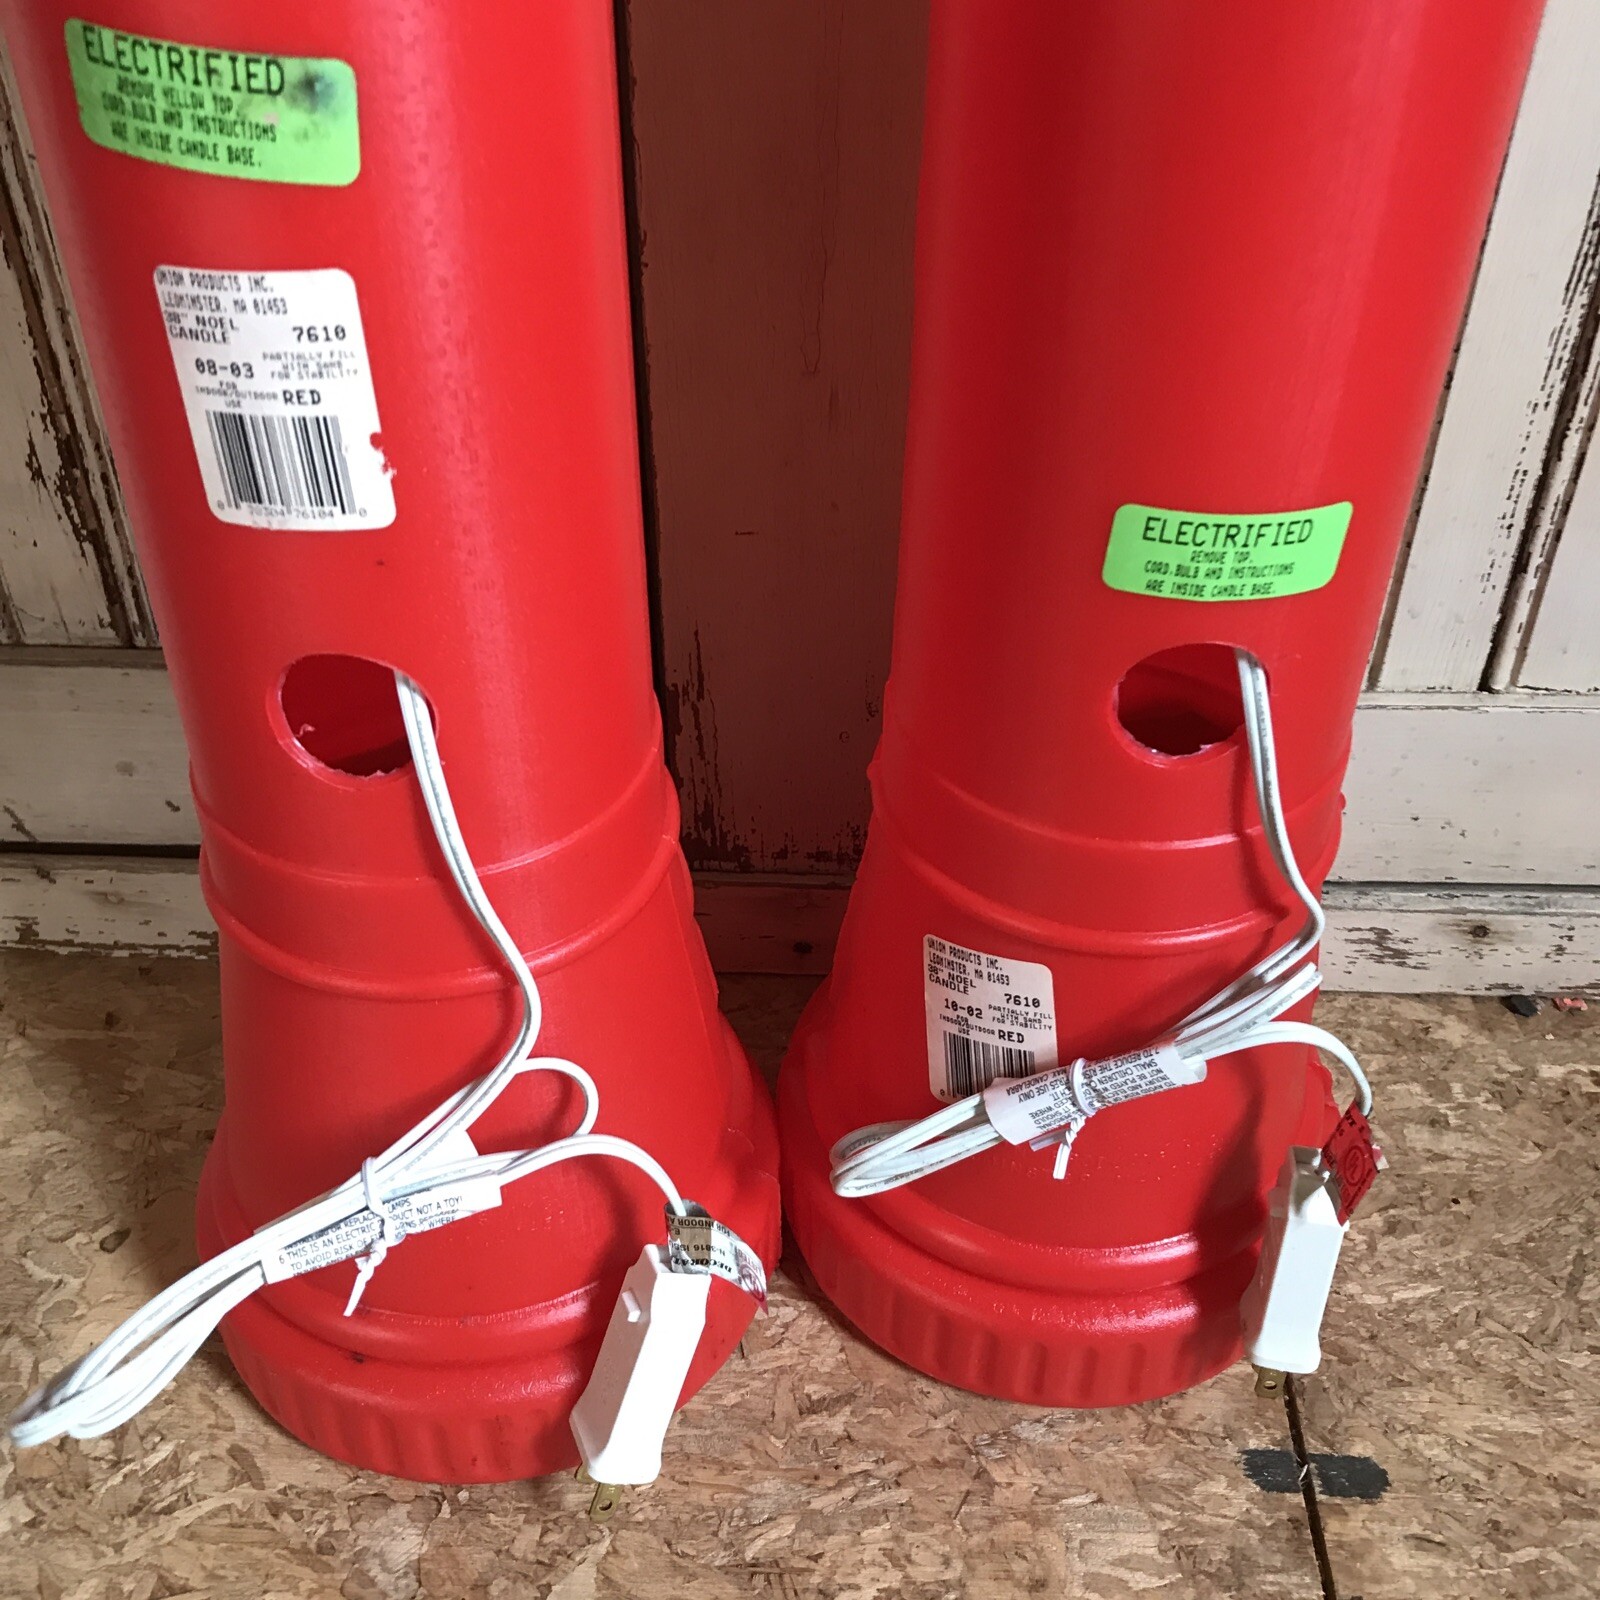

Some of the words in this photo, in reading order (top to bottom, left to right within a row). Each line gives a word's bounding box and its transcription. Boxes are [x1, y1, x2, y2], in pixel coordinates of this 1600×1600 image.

[82, 25, 284, 96] ELECTRIFIED
[162, 87, 204, 109] YELLOW
[163, 109, 183, 129] AND
[191, 112, 277, 143] INSTRUCTIONS
[110, 120, 129, 142] ARE
[134, 126, 172, 153] INSIDE
[177, 136, 219, 162] CANDLE
[189, 272, 241, 292] PRODUCTS
[248, 275, 274, 293] INC.
[233, 298, 247, 314] MA
[253, 296, 288, 315] 01453
[195, 315, 239, 331] NOEL
[169, 325, 231, 344] CANDLE
[292, 325, 346, 343] 7610
[262, 351, 323, 361] PARTIALLY
[329, 350, 356, 359] FILL
[195, 357, 254, 379] 08-03
[282, 389, 321, 406] RED
[294, 508, 334, 520] 76104
[1142, 516, 1313, 548] ELECTRIFIED
[1190, 550, 1227, 564] REMOVE
[1203, 567, 1223, 580] AND
[1228, 562, 1295, 579] INSTRUCTIONS
[1145, 579, 1165, 593] ARE
[1170, 582, 1206, 597] INSIDE
[1211, 583, 1247, 597] CANDLE
[949, 945, 981, 966] PRODUCTS
[986, 957, 1002, 971] INC.
[929, 973, 969, 995] CANDLE
[948, 972, 976, 988] NOEL
[974, 968, 983, 980] MA
[987, 971, 1010, 986] 01453
[1004, 993, 1041, 1008] 7610
[944, 998, 983, 1020] 10-02
[988, 1004, 1029, 1016] PARTIALLY
[1034, 1012, 1053, 1020] FILL
[956, 1014, 969, 1023] FOR
[992, 1016, 1006, 1025] FOR
[1010, 1020, 1053, 1031] STABILITY
[958, 1027, 970, 1036] USE
[998, 1029, 1025, 1044] RED
[1114, 1052, 1142, 1069] REDUCE
[1133, 1059, 1158, 1072] SMALL
[1097, 1067, 1134, 1085] CHILDREN
[1098, 1063, 1112, 1075] THE
[1147, 1067, 1164, 1077] NOT
[1006, 1074, 1049, 1096] CANDELABRA
[1110, 1078, 1137, 1090] PLAYED
[1127, 1084, 1143, 1092] AND
[1145, 1074, 1170, 1087] INJURY
[1018, 1089, 1035, 1104] ONLY
[1035, 1084, 1050, 1097] USE
[1029, 1105, 1055, 1119] WHERE
[1034, 1110, 1063, 1125] SHOULD
[677, 1217, 714, 1228] INDOOR
[287, 1246, 308, 1260] THIS
[310, 1242, 320, 1253] IS
[322, 1238, 334, 1248] AN
[335, 1222, 375, 1244] ELECTRIC
[416, 1203, 433, 1215] NOT
[291, 1262, 303, 1271] TO
[305, 1251, 332, 1266] AVOID
[334, 1243, 354, 1256] RISK
[357, 1238, 368, 1248] OF
